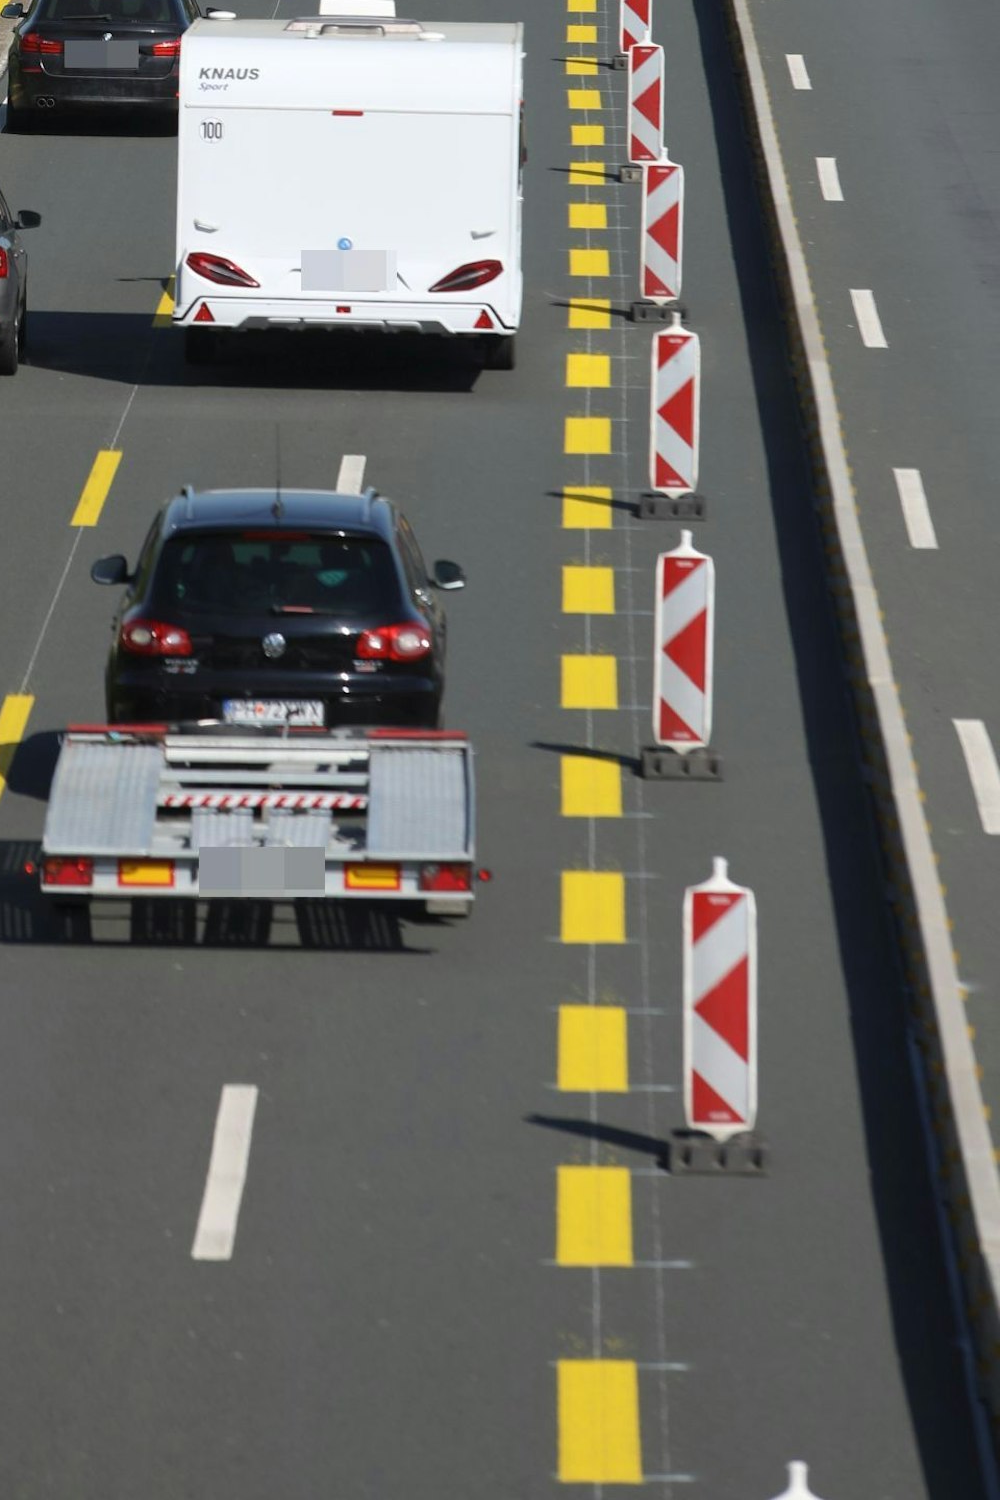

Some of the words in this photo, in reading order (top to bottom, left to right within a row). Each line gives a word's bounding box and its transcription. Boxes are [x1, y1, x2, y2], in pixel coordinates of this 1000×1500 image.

[198, 67, 260, 81] KNAUS
[198, 82, 230, 93] Sport
[201, 121, 223, 140] 100
